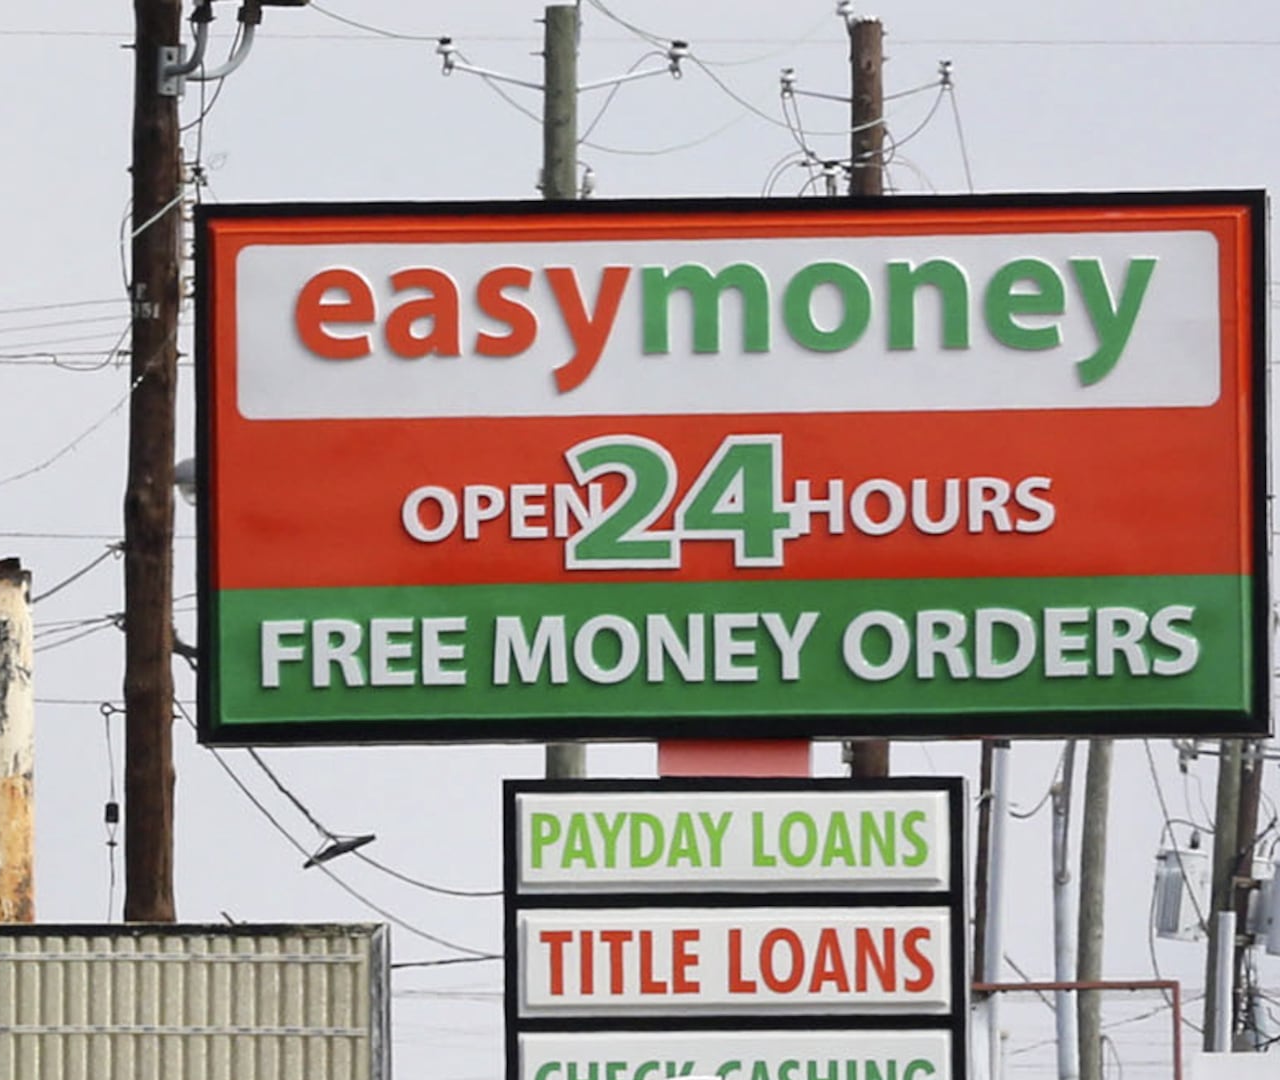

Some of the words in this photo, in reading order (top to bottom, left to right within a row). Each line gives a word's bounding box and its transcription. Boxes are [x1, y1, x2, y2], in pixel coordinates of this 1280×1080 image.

[294, 256, 1157, 394] easymoney
[402, 484, 601, 543] OPEN
[563, 433, 799, 571] 24
[793, 475, 1056, 535] HOURS
[260, 616, 466, 687] FREE
[492, 610, 820, 685] MONEY
[841, 604, 1201, 679] ORDERS
[530, 811, 732, 868] PAYDAY
[751, 810, 929, 867] LOANS
[540, 930, 700, 995] TITLE
[728, 927, 934, 994] LOANS
